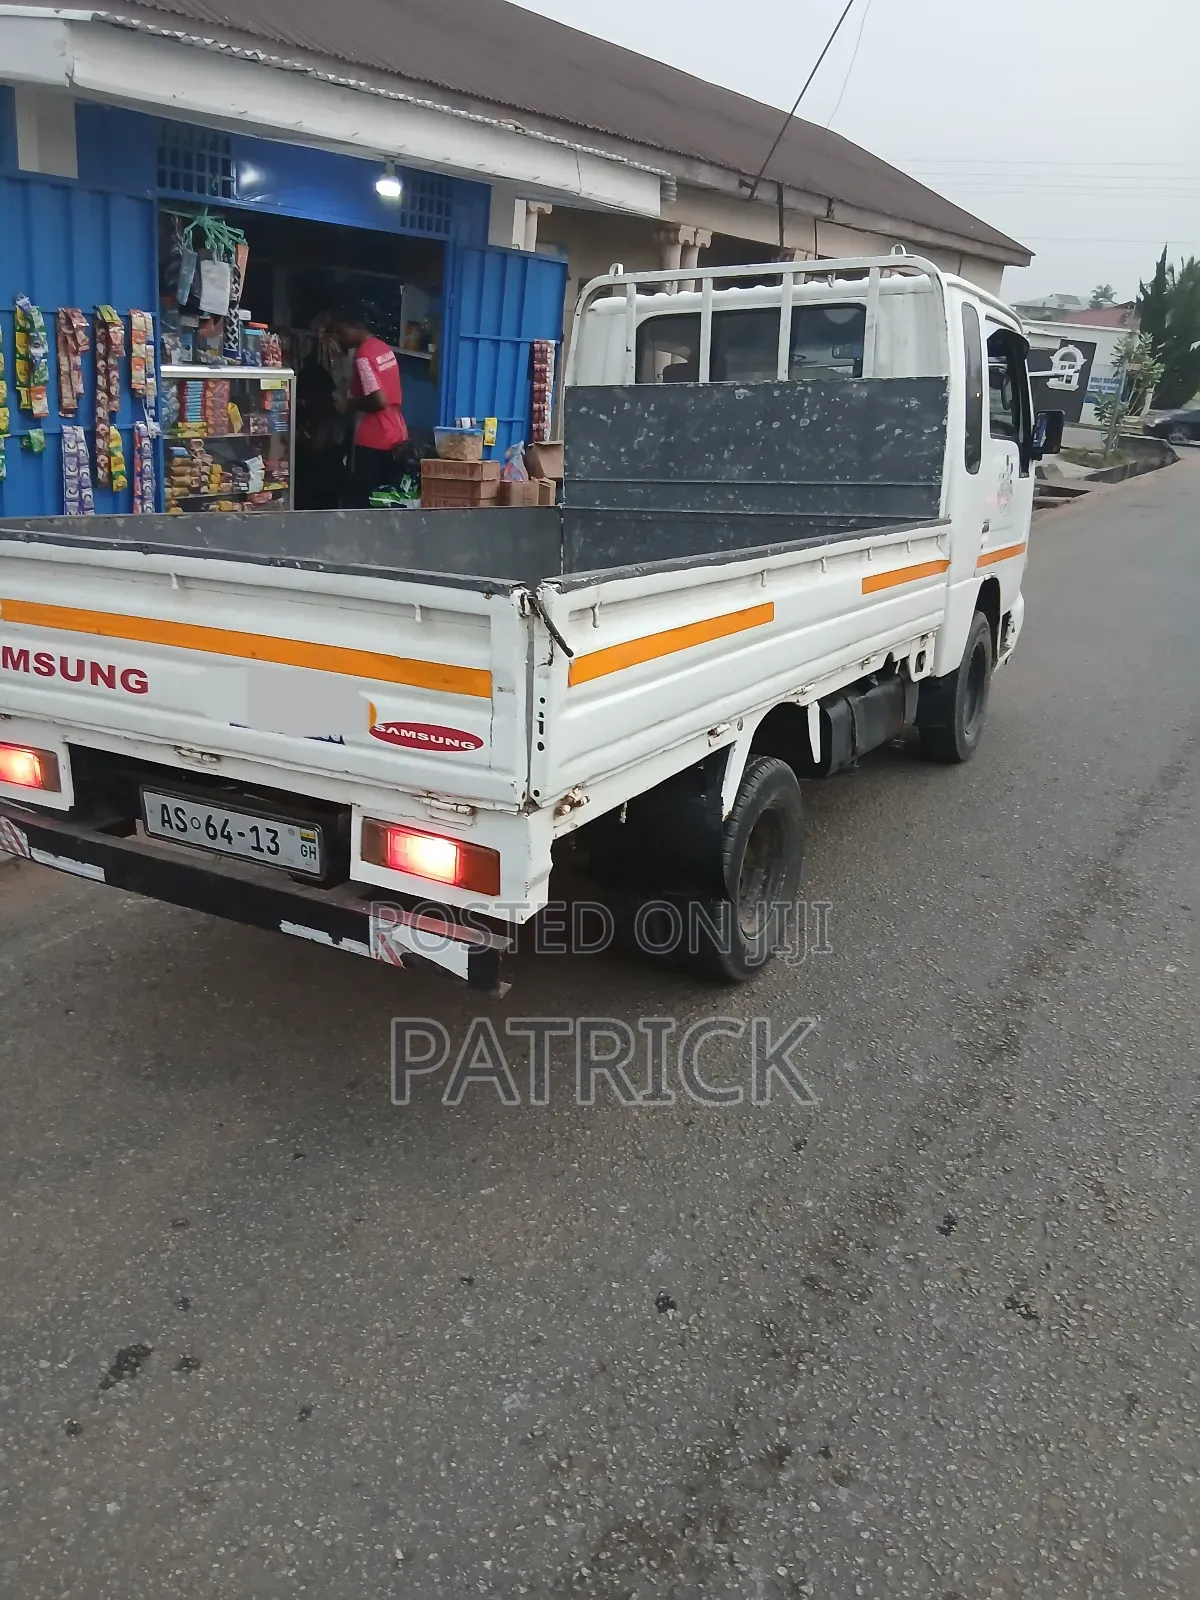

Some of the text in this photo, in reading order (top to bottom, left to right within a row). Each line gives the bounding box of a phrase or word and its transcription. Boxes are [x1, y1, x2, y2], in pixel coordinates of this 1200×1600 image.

[1, 645, 149, 695] MSUNG
[374, 724, 476, 750] SAMSUNG
[160, 803, 280, 856] AS 64-13
[300, 844, 317, 861] GH
